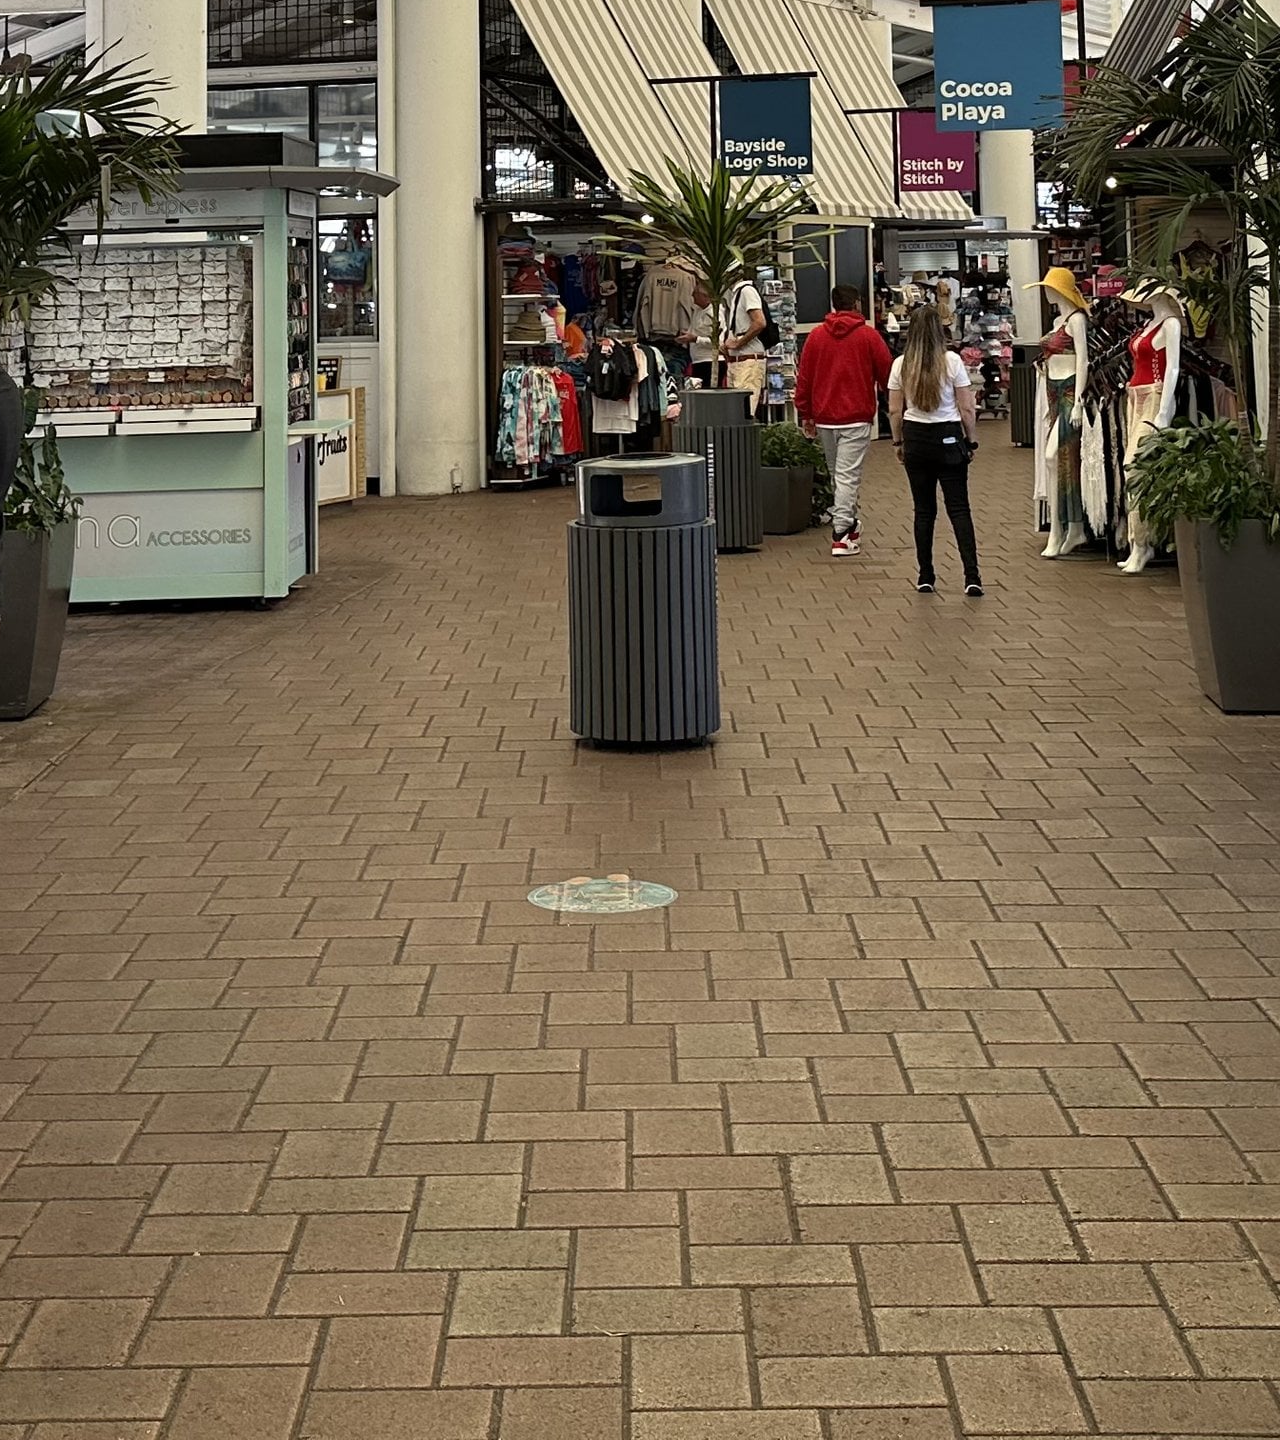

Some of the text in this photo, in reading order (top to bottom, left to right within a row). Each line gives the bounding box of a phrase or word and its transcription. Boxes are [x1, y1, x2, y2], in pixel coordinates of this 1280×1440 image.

[940, 80, 1013, 98] Cocoa
[941, 104, 1006, 124] Playa
[724, 139, 786, 155] Bayside
[725, 154, 808, 171] Logo Shop
[902, 159, 964, 174] Stitch by
[903, 173, 944, 185] Stitch
[145, 199, 217, 218] Express
[907, 242, 955, 250] COLLECTIONS
[317, 430, 348, 465] rfruits
[146, 528, 252, 548] ACCESSORIES
